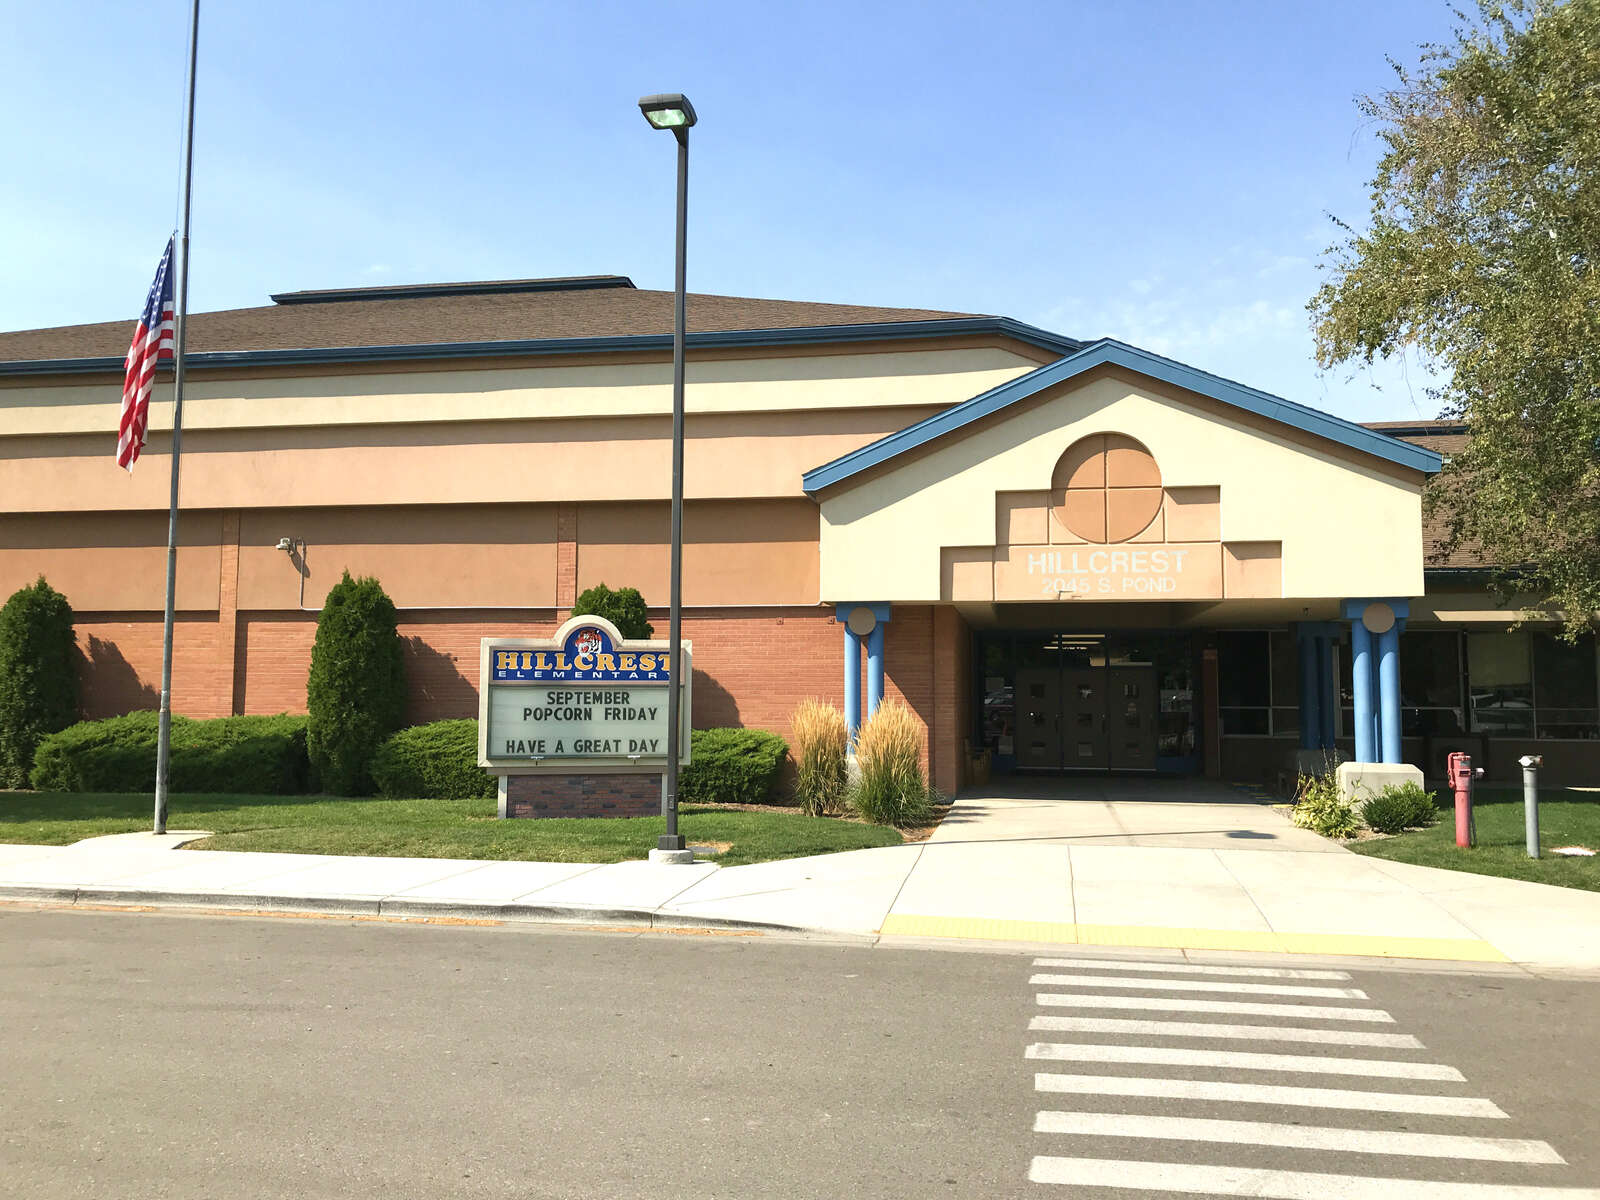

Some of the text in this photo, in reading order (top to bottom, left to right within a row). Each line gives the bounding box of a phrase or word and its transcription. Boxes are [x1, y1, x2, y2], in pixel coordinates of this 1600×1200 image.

[1028, 550, 1188, 574] HILLCREST
[1042, 576, 1176, 593] 2045 S. POND
[496, 652, 670, 671] HILLCREST
[498, 671, 670, 679] ELEMENTAR
[547, 691, 630, 705] SEPTEMBER
[523, 707, 658, 721] POPCORN FRIDAY
[506, 739, 659, 753] HAVE A GREAT DAY
